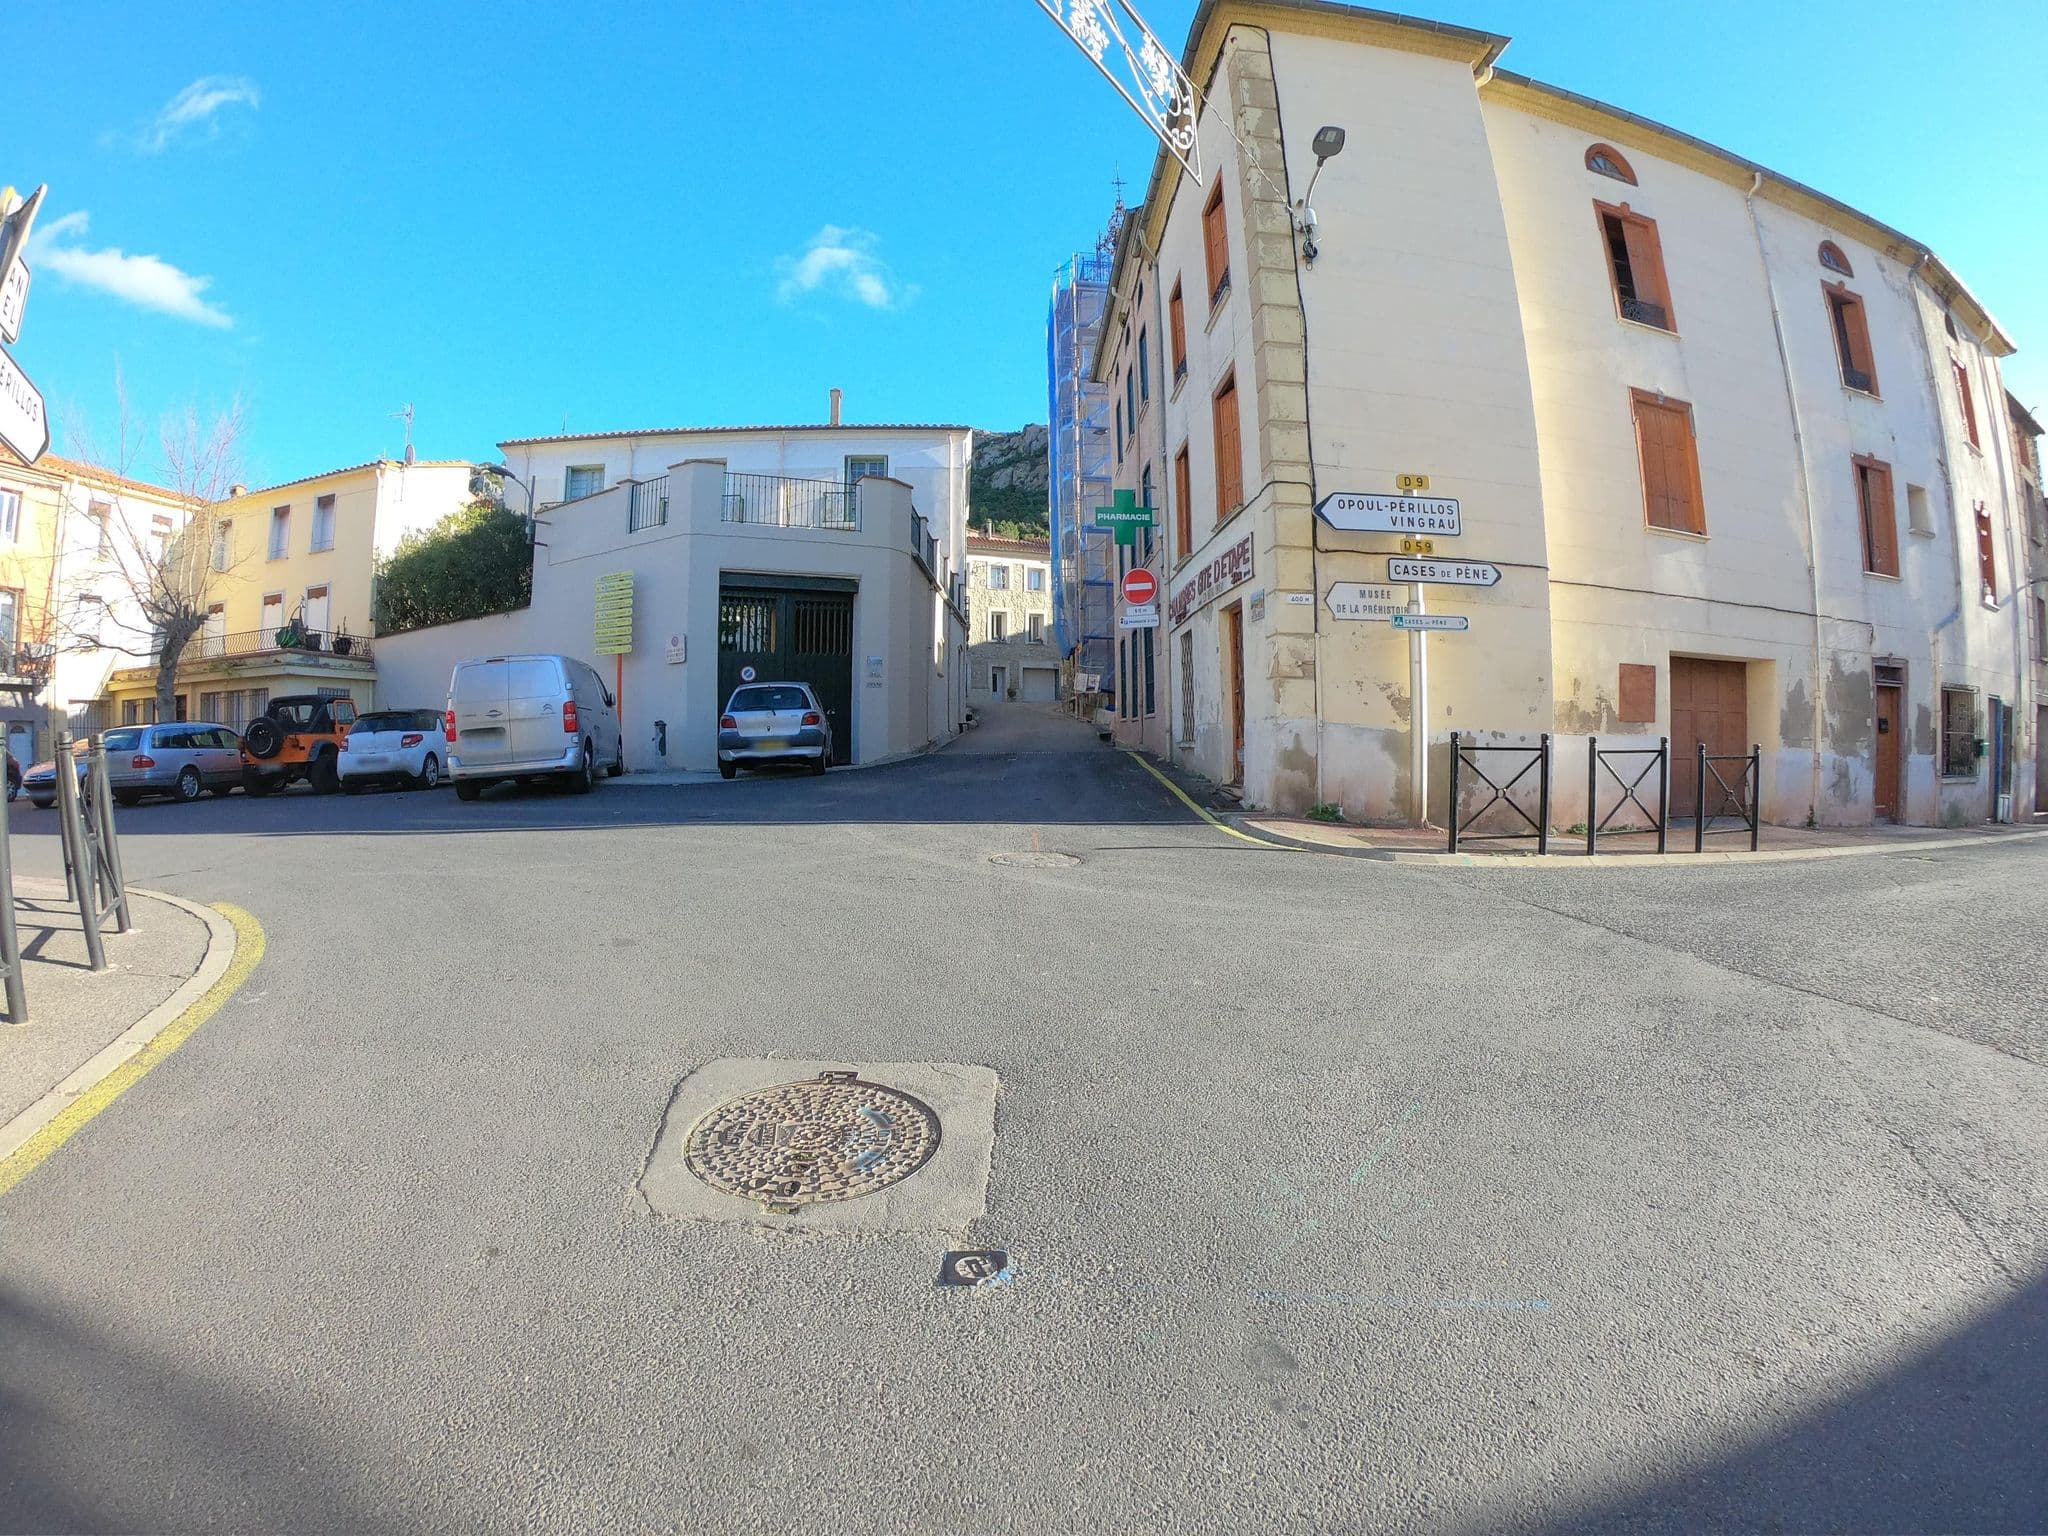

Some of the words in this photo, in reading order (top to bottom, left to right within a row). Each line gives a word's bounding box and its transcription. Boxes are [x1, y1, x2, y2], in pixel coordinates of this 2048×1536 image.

[1404, 476, 1411, 487] D
[1416, 477, 1423, 487] 9
[1337, 499, 1455, 515] OPOUL-PÉRILLOS
[1097, 512, 1151, 521] PHARMACIE
[1390, 516, 1455, 530] VINGRAU
[1404, 540, 1411, 552] D
[1415, 541, 1432, 553] 59
[1394, 564, 1436, 577] CASES
[1441, 570, 1451, 578] DE
[1359, 589, 1392, 600] MUSÉE
[1336, 604, 1346, 613] DE
[1350, 604, 1360, 614] LA
[1363, 604, 1409, 615] PRÉHISTOIR
